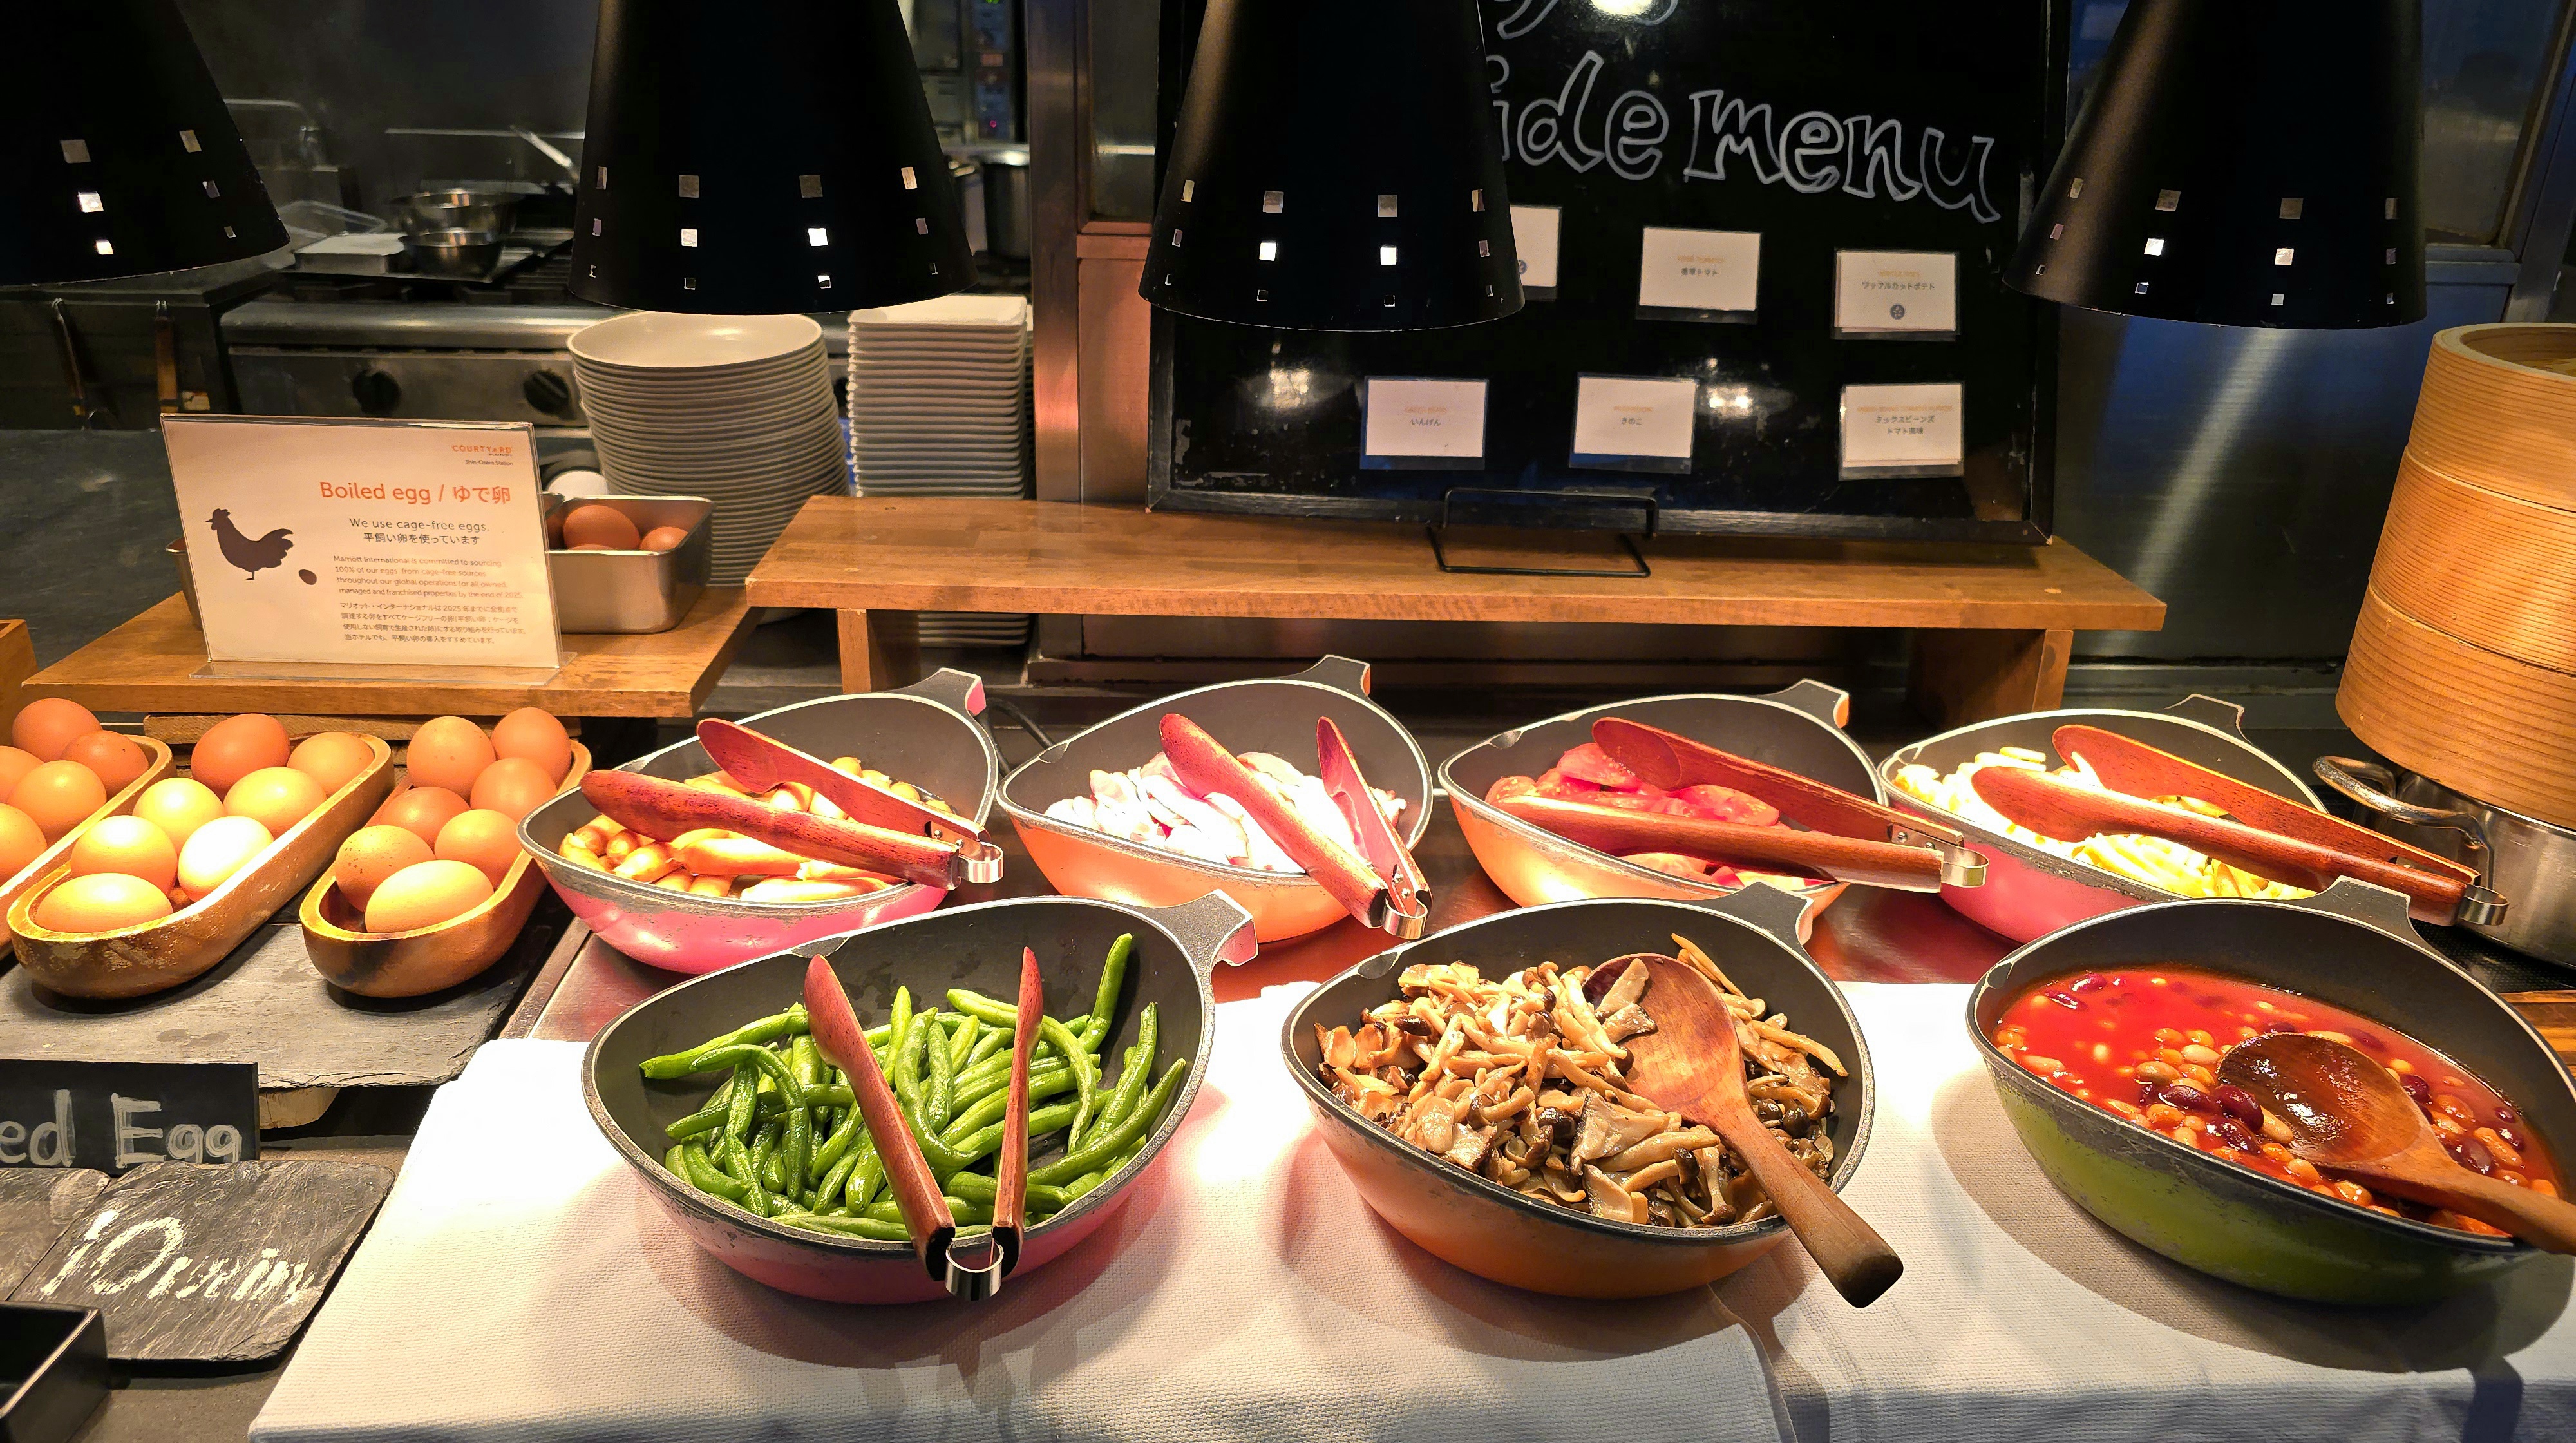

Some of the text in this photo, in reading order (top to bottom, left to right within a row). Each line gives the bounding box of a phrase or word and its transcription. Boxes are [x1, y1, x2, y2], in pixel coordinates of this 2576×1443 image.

[1683, 89, 2001, 224] menu
[452, 444, 513, 454] COURTYARD
[320, 481, 511, 505] Boiled egg / ゆで卵
[349, 518, 490, 533] We use cage-free eggs.
[363, 533, 480, 545] 平飼い卵を使っています
[337, 577, 378, 586] throughout
